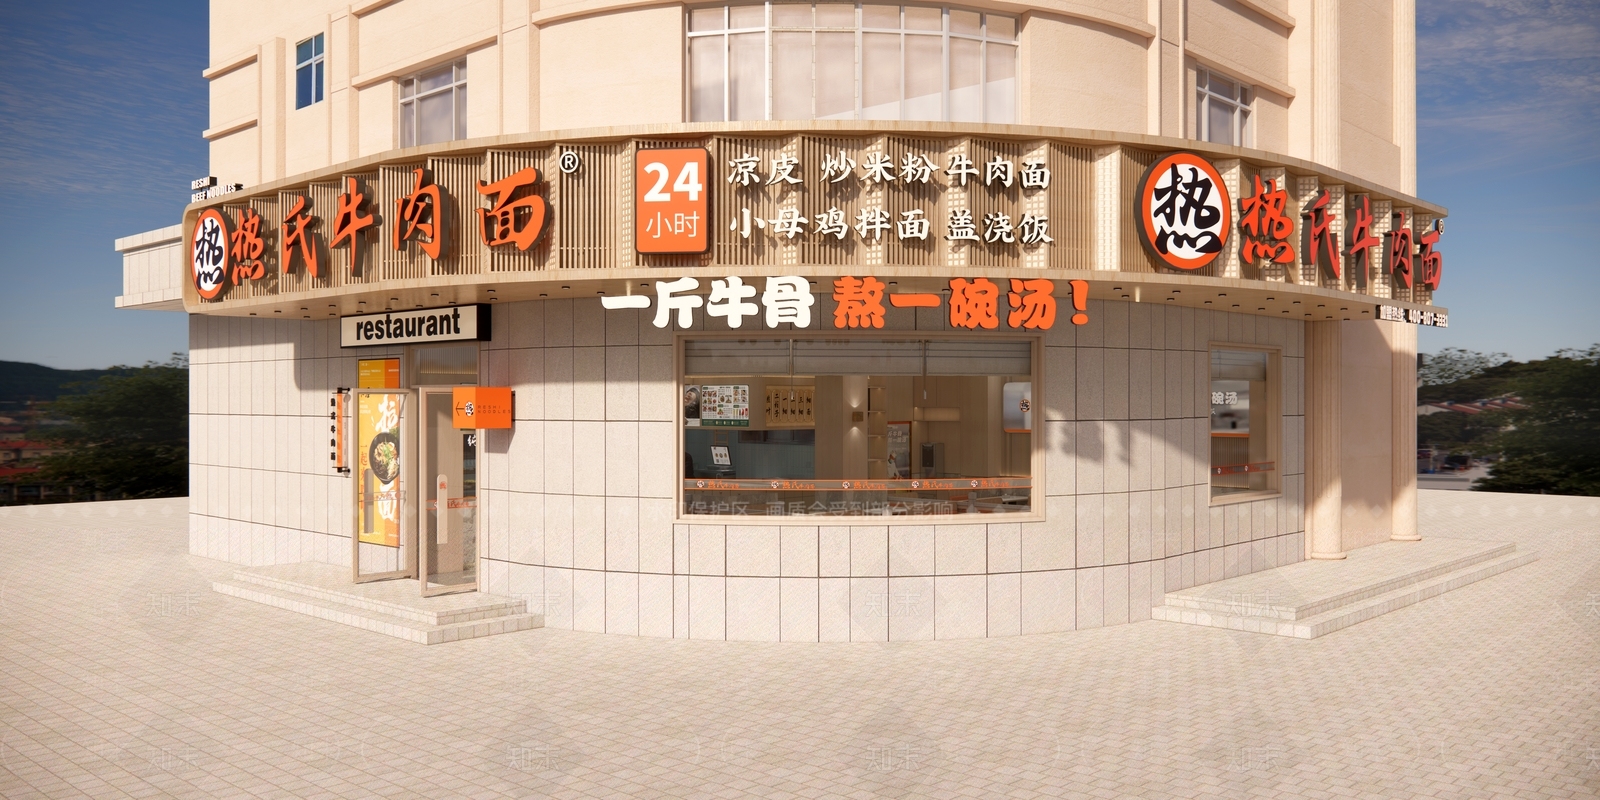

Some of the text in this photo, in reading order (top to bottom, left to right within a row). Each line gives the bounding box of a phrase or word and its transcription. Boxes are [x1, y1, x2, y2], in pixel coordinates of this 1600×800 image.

[191, 190, 206, 203] BEEF
[643, 161, 703, 202] 24
[231, 167, 547, 286] 热氏牛肉面
[645, 210, 700, 239] 小时
[1240, 174, 1442, 291] 热氏牛肉面
[600, 276, 815, 329] 一斤牛骨
[356, 308, 461, 341] restaurant
